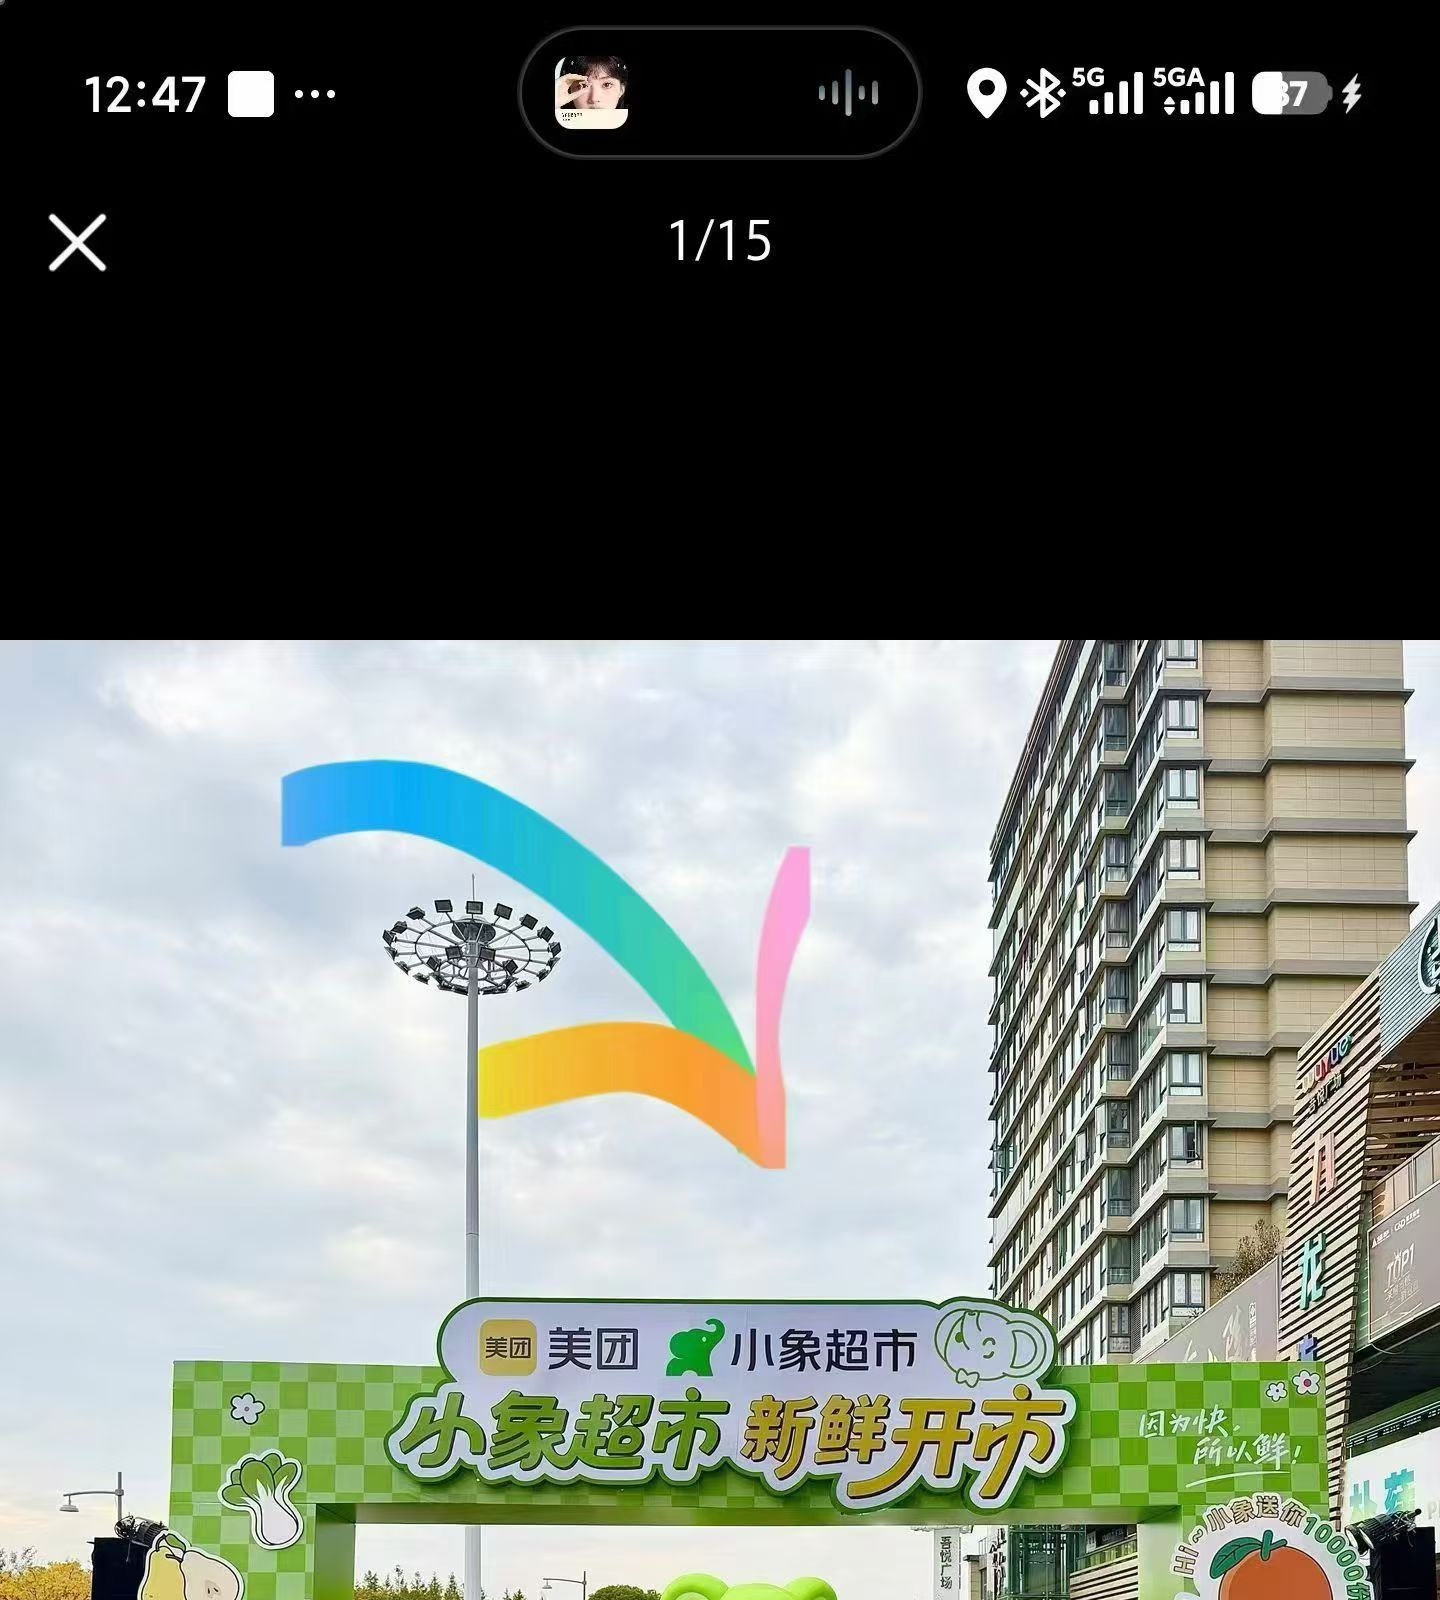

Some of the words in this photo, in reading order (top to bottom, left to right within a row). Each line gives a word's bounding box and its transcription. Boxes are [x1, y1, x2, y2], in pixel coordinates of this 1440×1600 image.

[485, 1336, 532, 1359] 美团
[548, 1326, 639, 1371] 美团
[730, 1328, 918, 1372] 小象超市
[399, 1386, 731, 1471] 小象超市
[739, 1383, 1068, 1500] 新鲜开市
[940, 1535, 953, 1590] 吾悦广场
